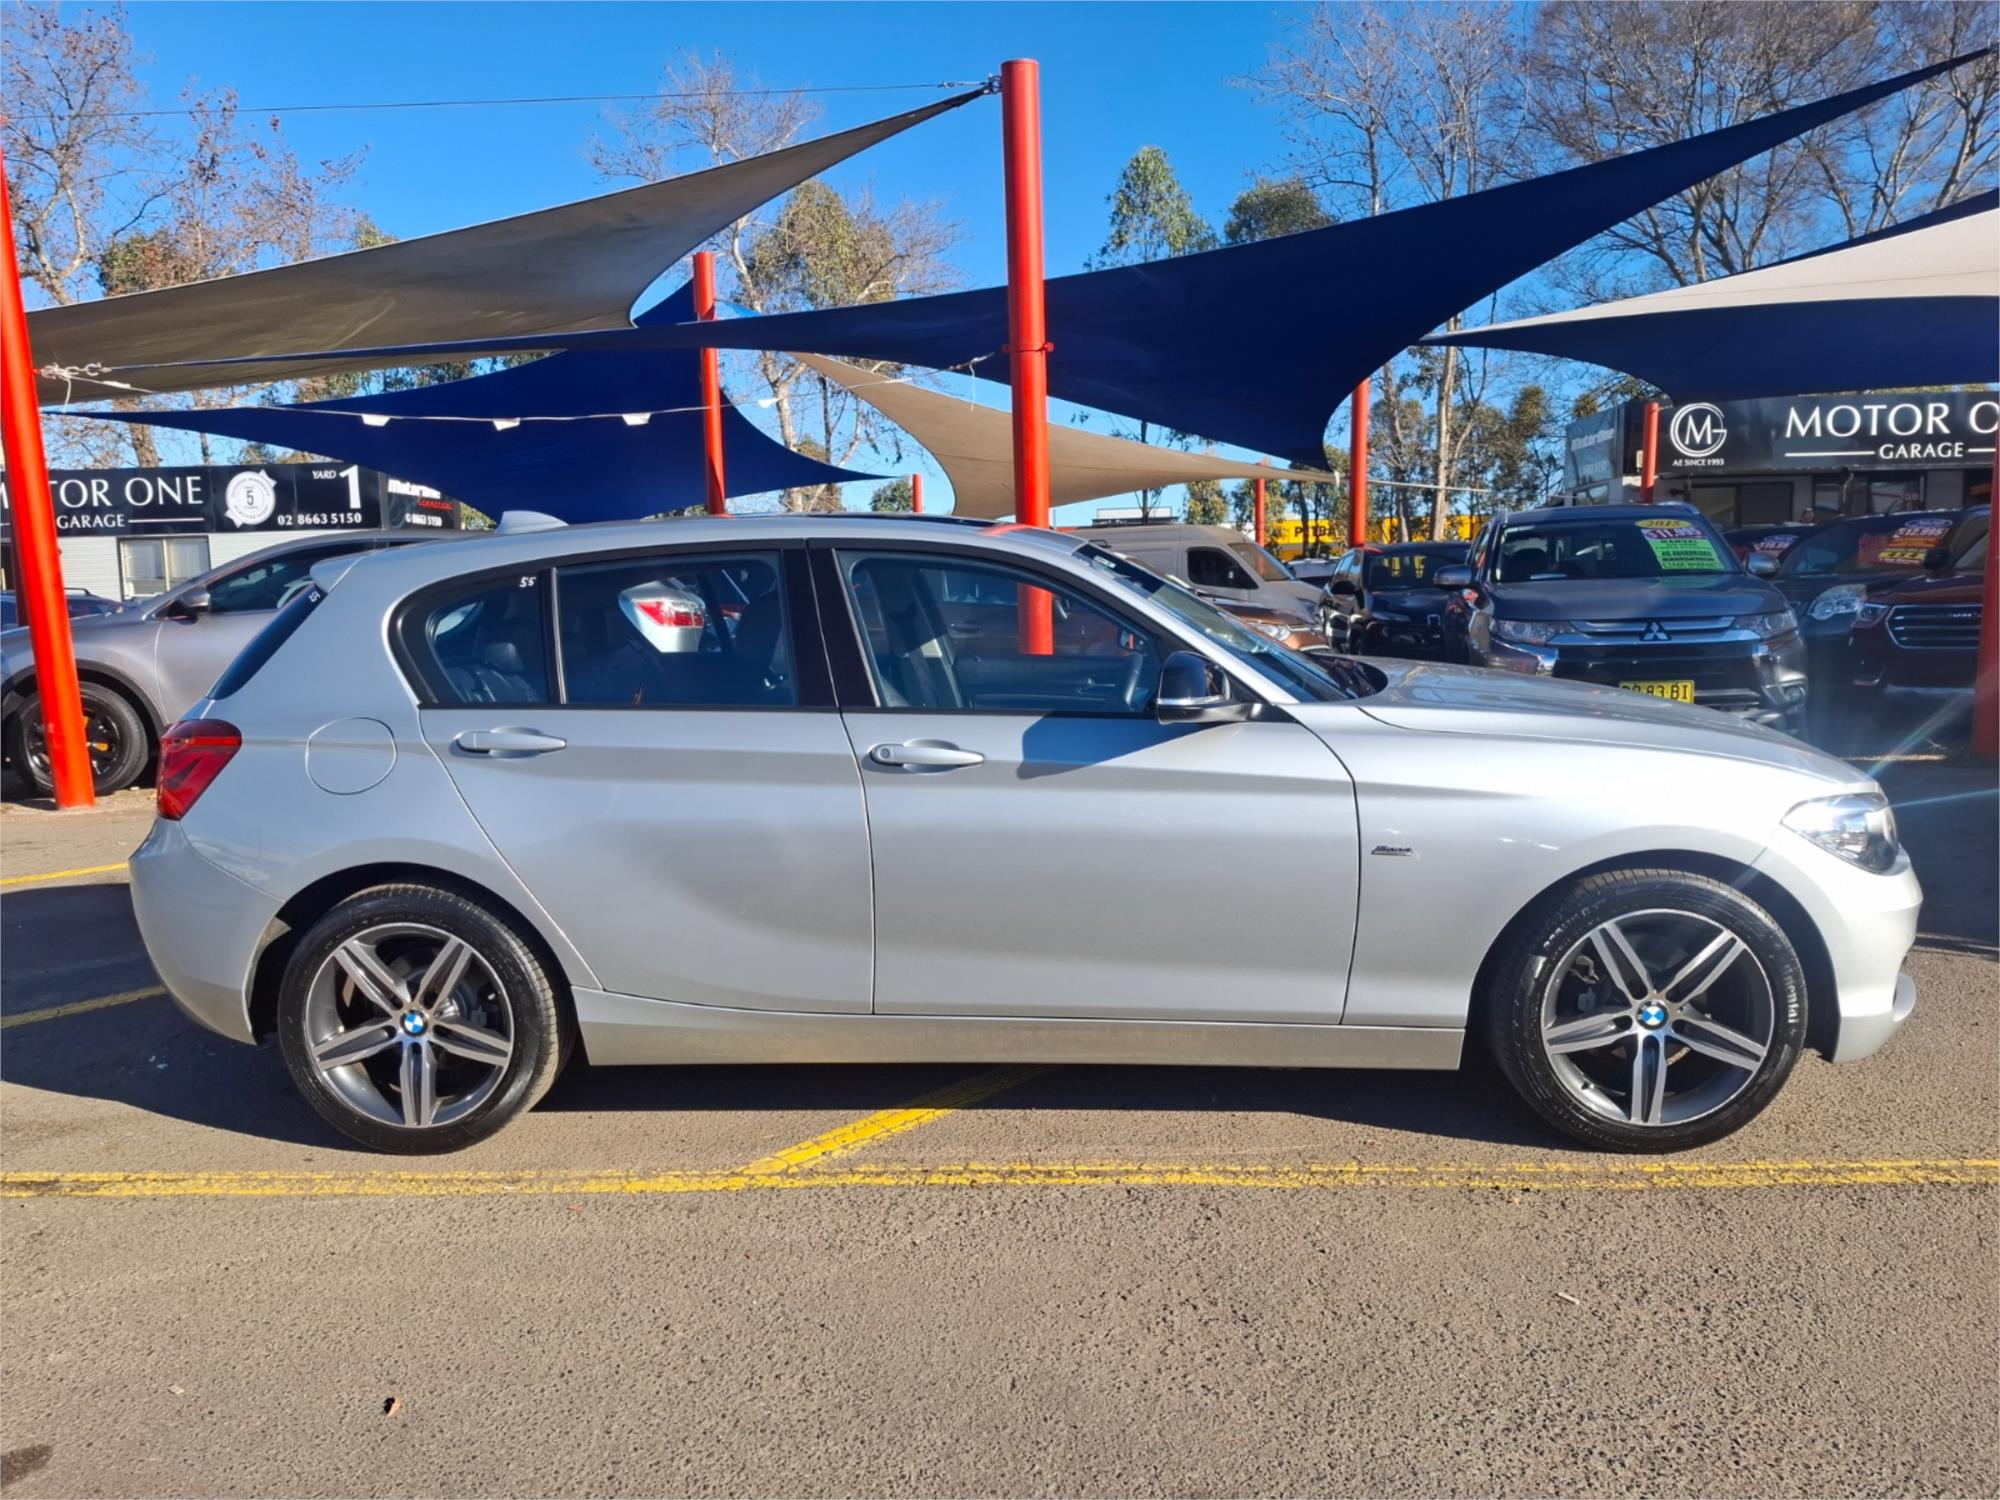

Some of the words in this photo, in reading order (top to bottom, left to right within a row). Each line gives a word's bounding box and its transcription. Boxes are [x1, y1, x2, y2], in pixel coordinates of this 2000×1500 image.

[1785, 403, 1950, 438] MOTOR
[1878, 442, 1964, 460] GARAGE
[1684, 459, 1706, 467] SINCE
[124, 476, 204, 507] ONE
[312, 470, 337, 480] YARD
[339, 464, 362, 509] 1
[246, 490, 255, 506] 5
[56, 514, 126, 530] GARAGE
[277, 514, 293, 526] 02
[297, 513, 328, 525] 8663
[330, 512, 362, 524] 5150
